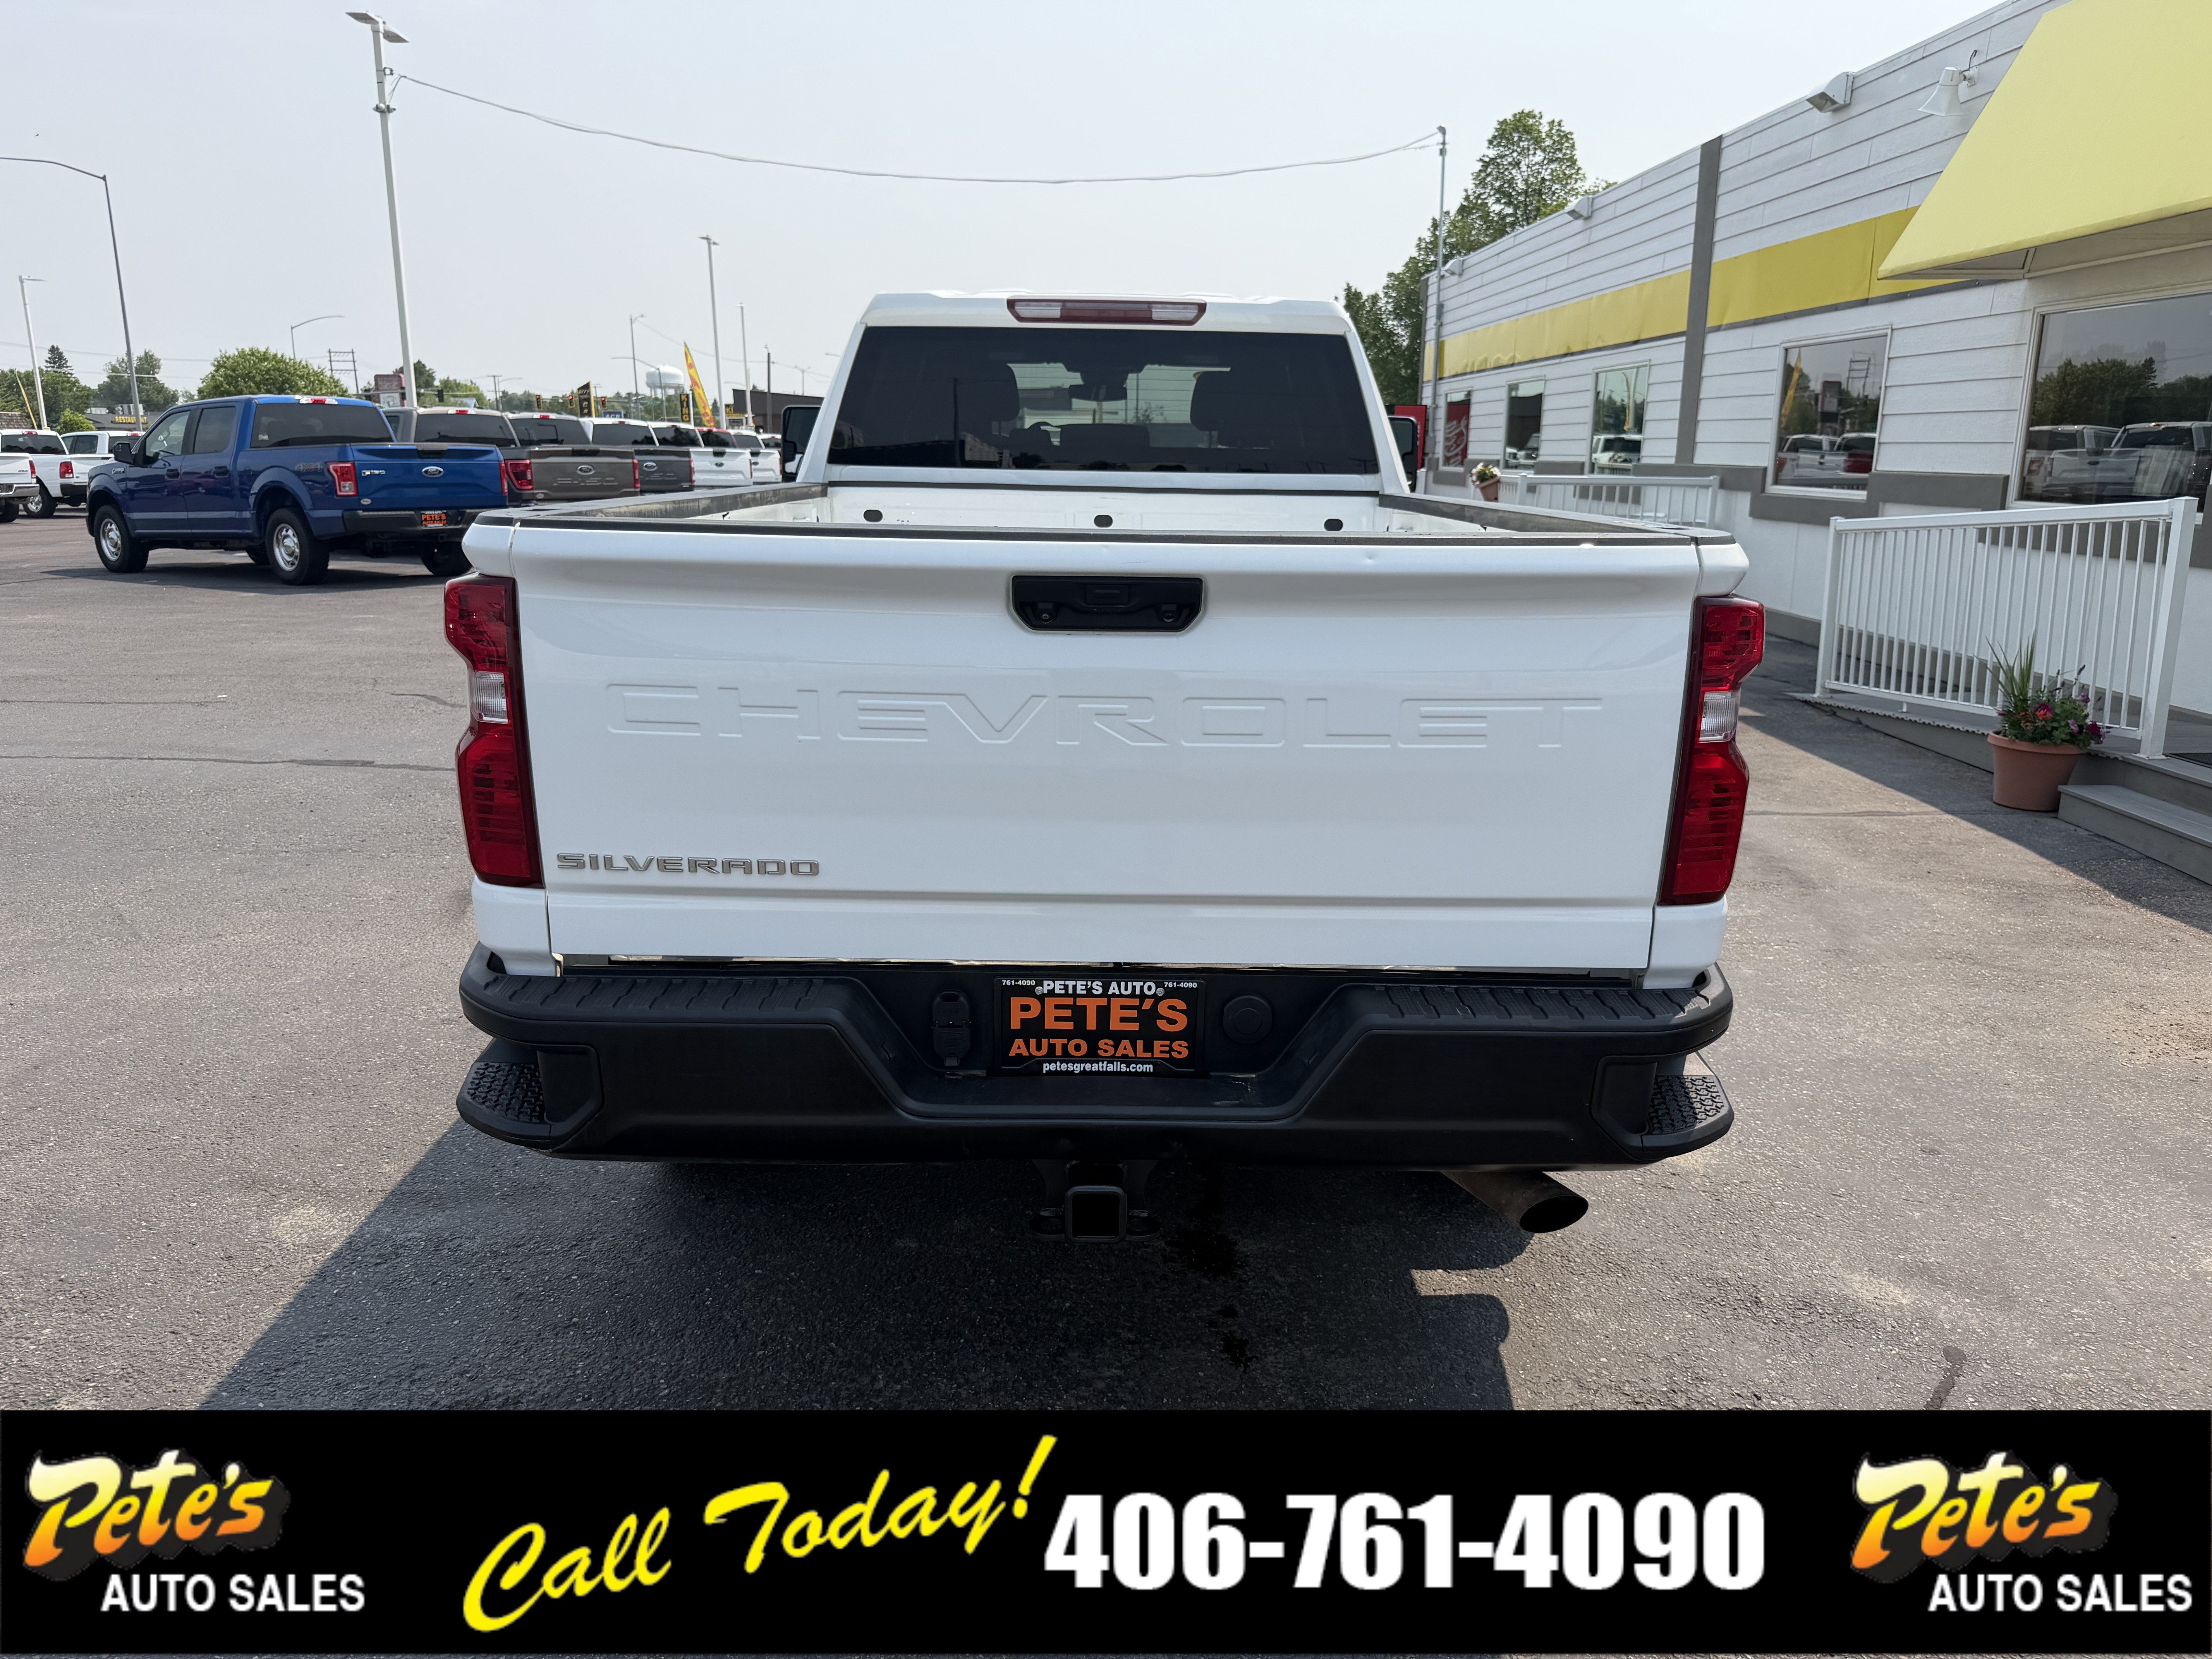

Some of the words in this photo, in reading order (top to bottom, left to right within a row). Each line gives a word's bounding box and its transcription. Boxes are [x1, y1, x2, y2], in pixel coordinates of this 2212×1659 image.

[606, 683, 1603, 748] CHEVROLET
[556, 852, 819, 876] SILVERADO
[1042, 980, 1103, 994] PETE'S
[1108, 981, 1156, 995] AUTO
[1010, 997, 1188, 1032] PETE'S
[1009, 1039, 1087, 1056] AUTO
[1097, 1039, 1188, 1058] SALES
[1043, 1061, 1153, 1073] petesgreatfalls.com
